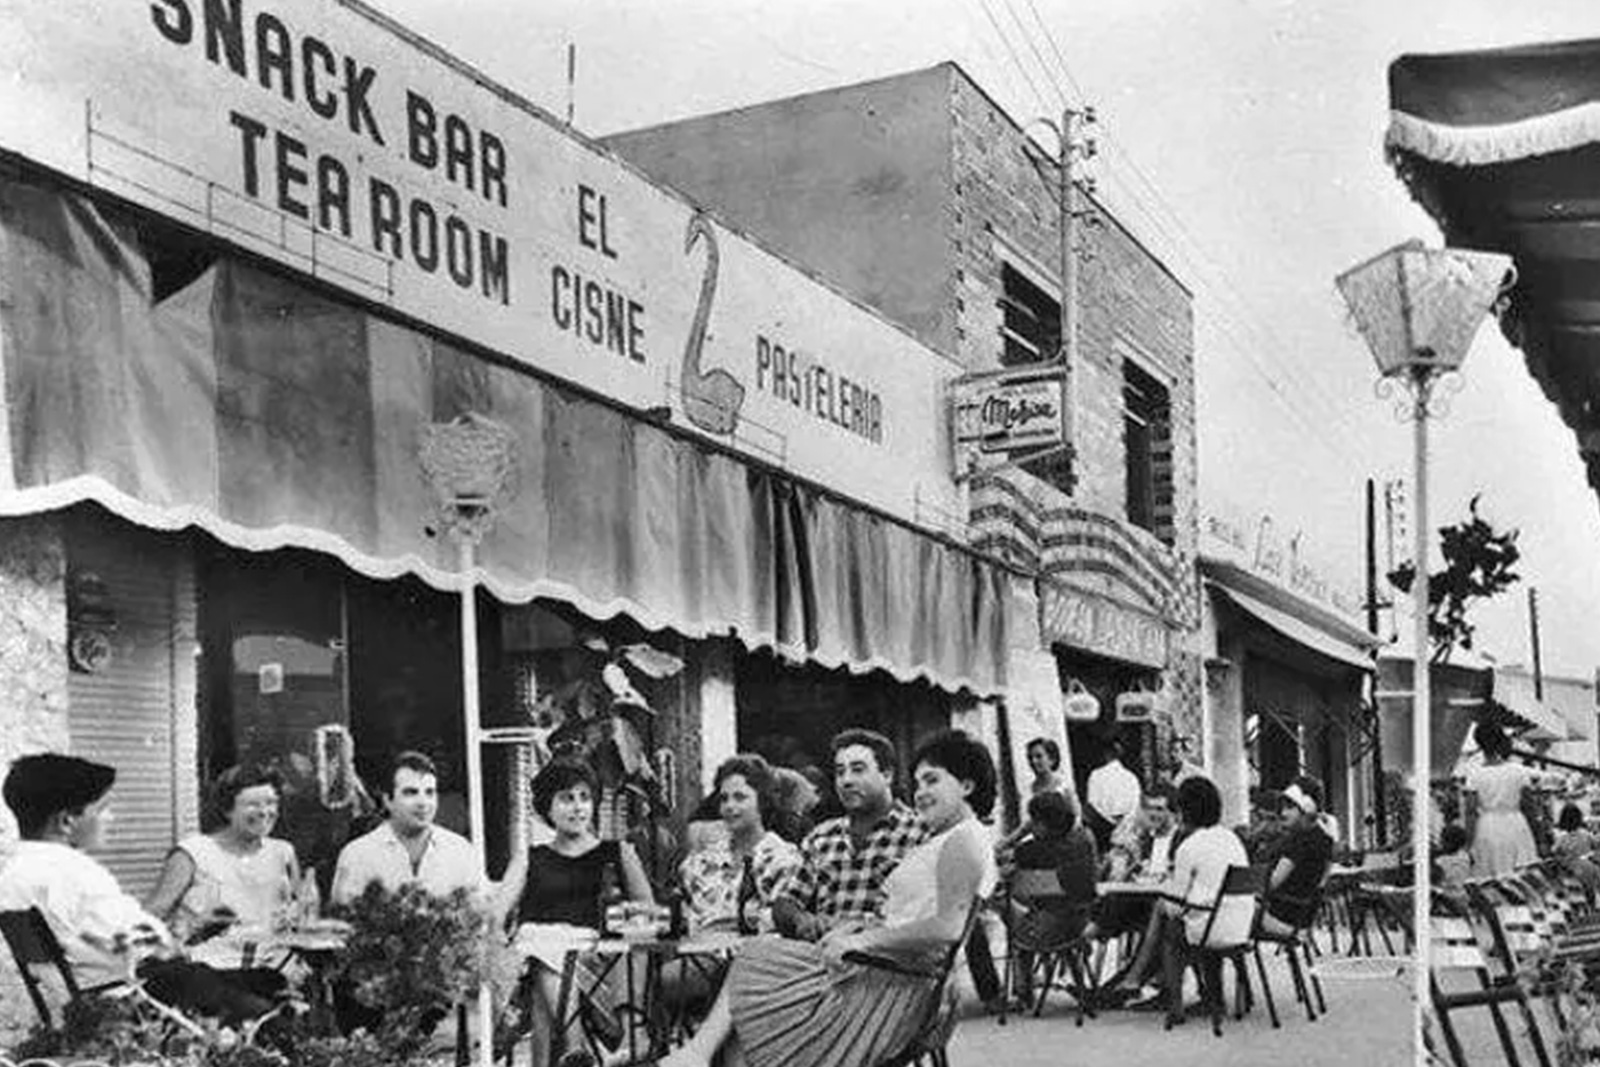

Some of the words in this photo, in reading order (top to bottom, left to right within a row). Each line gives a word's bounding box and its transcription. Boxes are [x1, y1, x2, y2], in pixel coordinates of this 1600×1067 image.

[406, 88, 509, 208] BAR
[229, 109, 351, 237] TEA
[369, 175, 510, 306] ROOM
[577, 183, 619, 259] EL
[551, 264, 647, 364] CISNE
[756, 334, 883, 446] PASTELERIA
